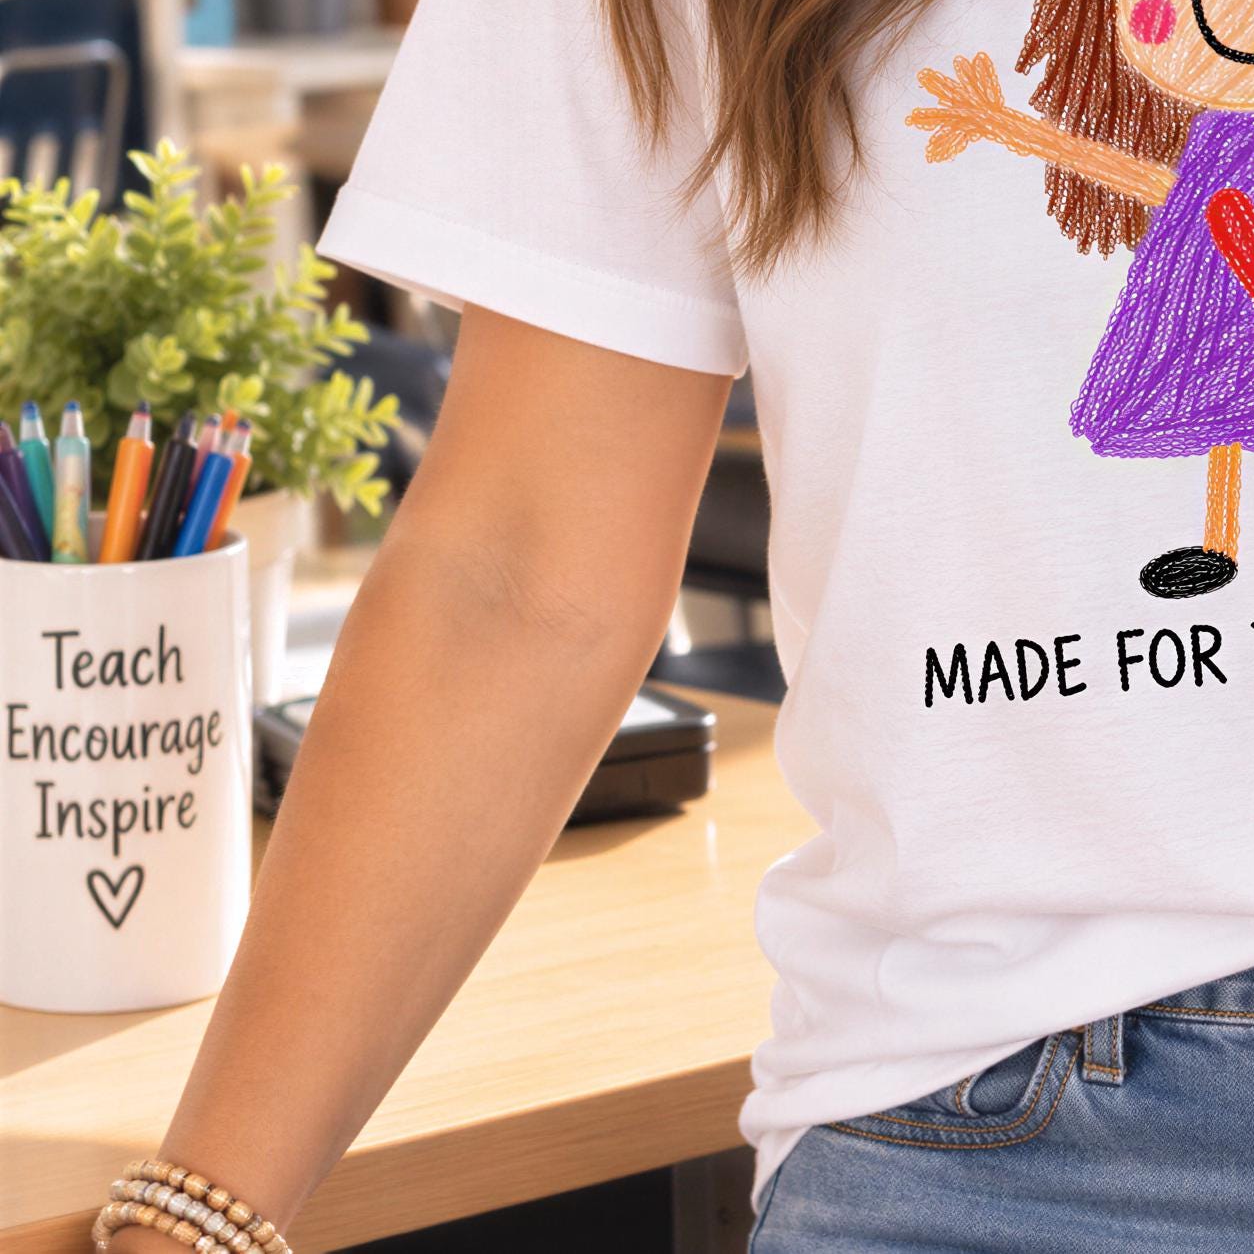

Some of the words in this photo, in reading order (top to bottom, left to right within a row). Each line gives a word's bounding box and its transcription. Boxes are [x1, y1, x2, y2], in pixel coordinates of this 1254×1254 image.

[42, 624, 184, 690] Teach
[925, 634, 1086, 707] MADE
[1117, 625, 1227, 691] FOR
[7, 703, 223, 775] Encourage
[35, 781, 197, 857] Inspire
